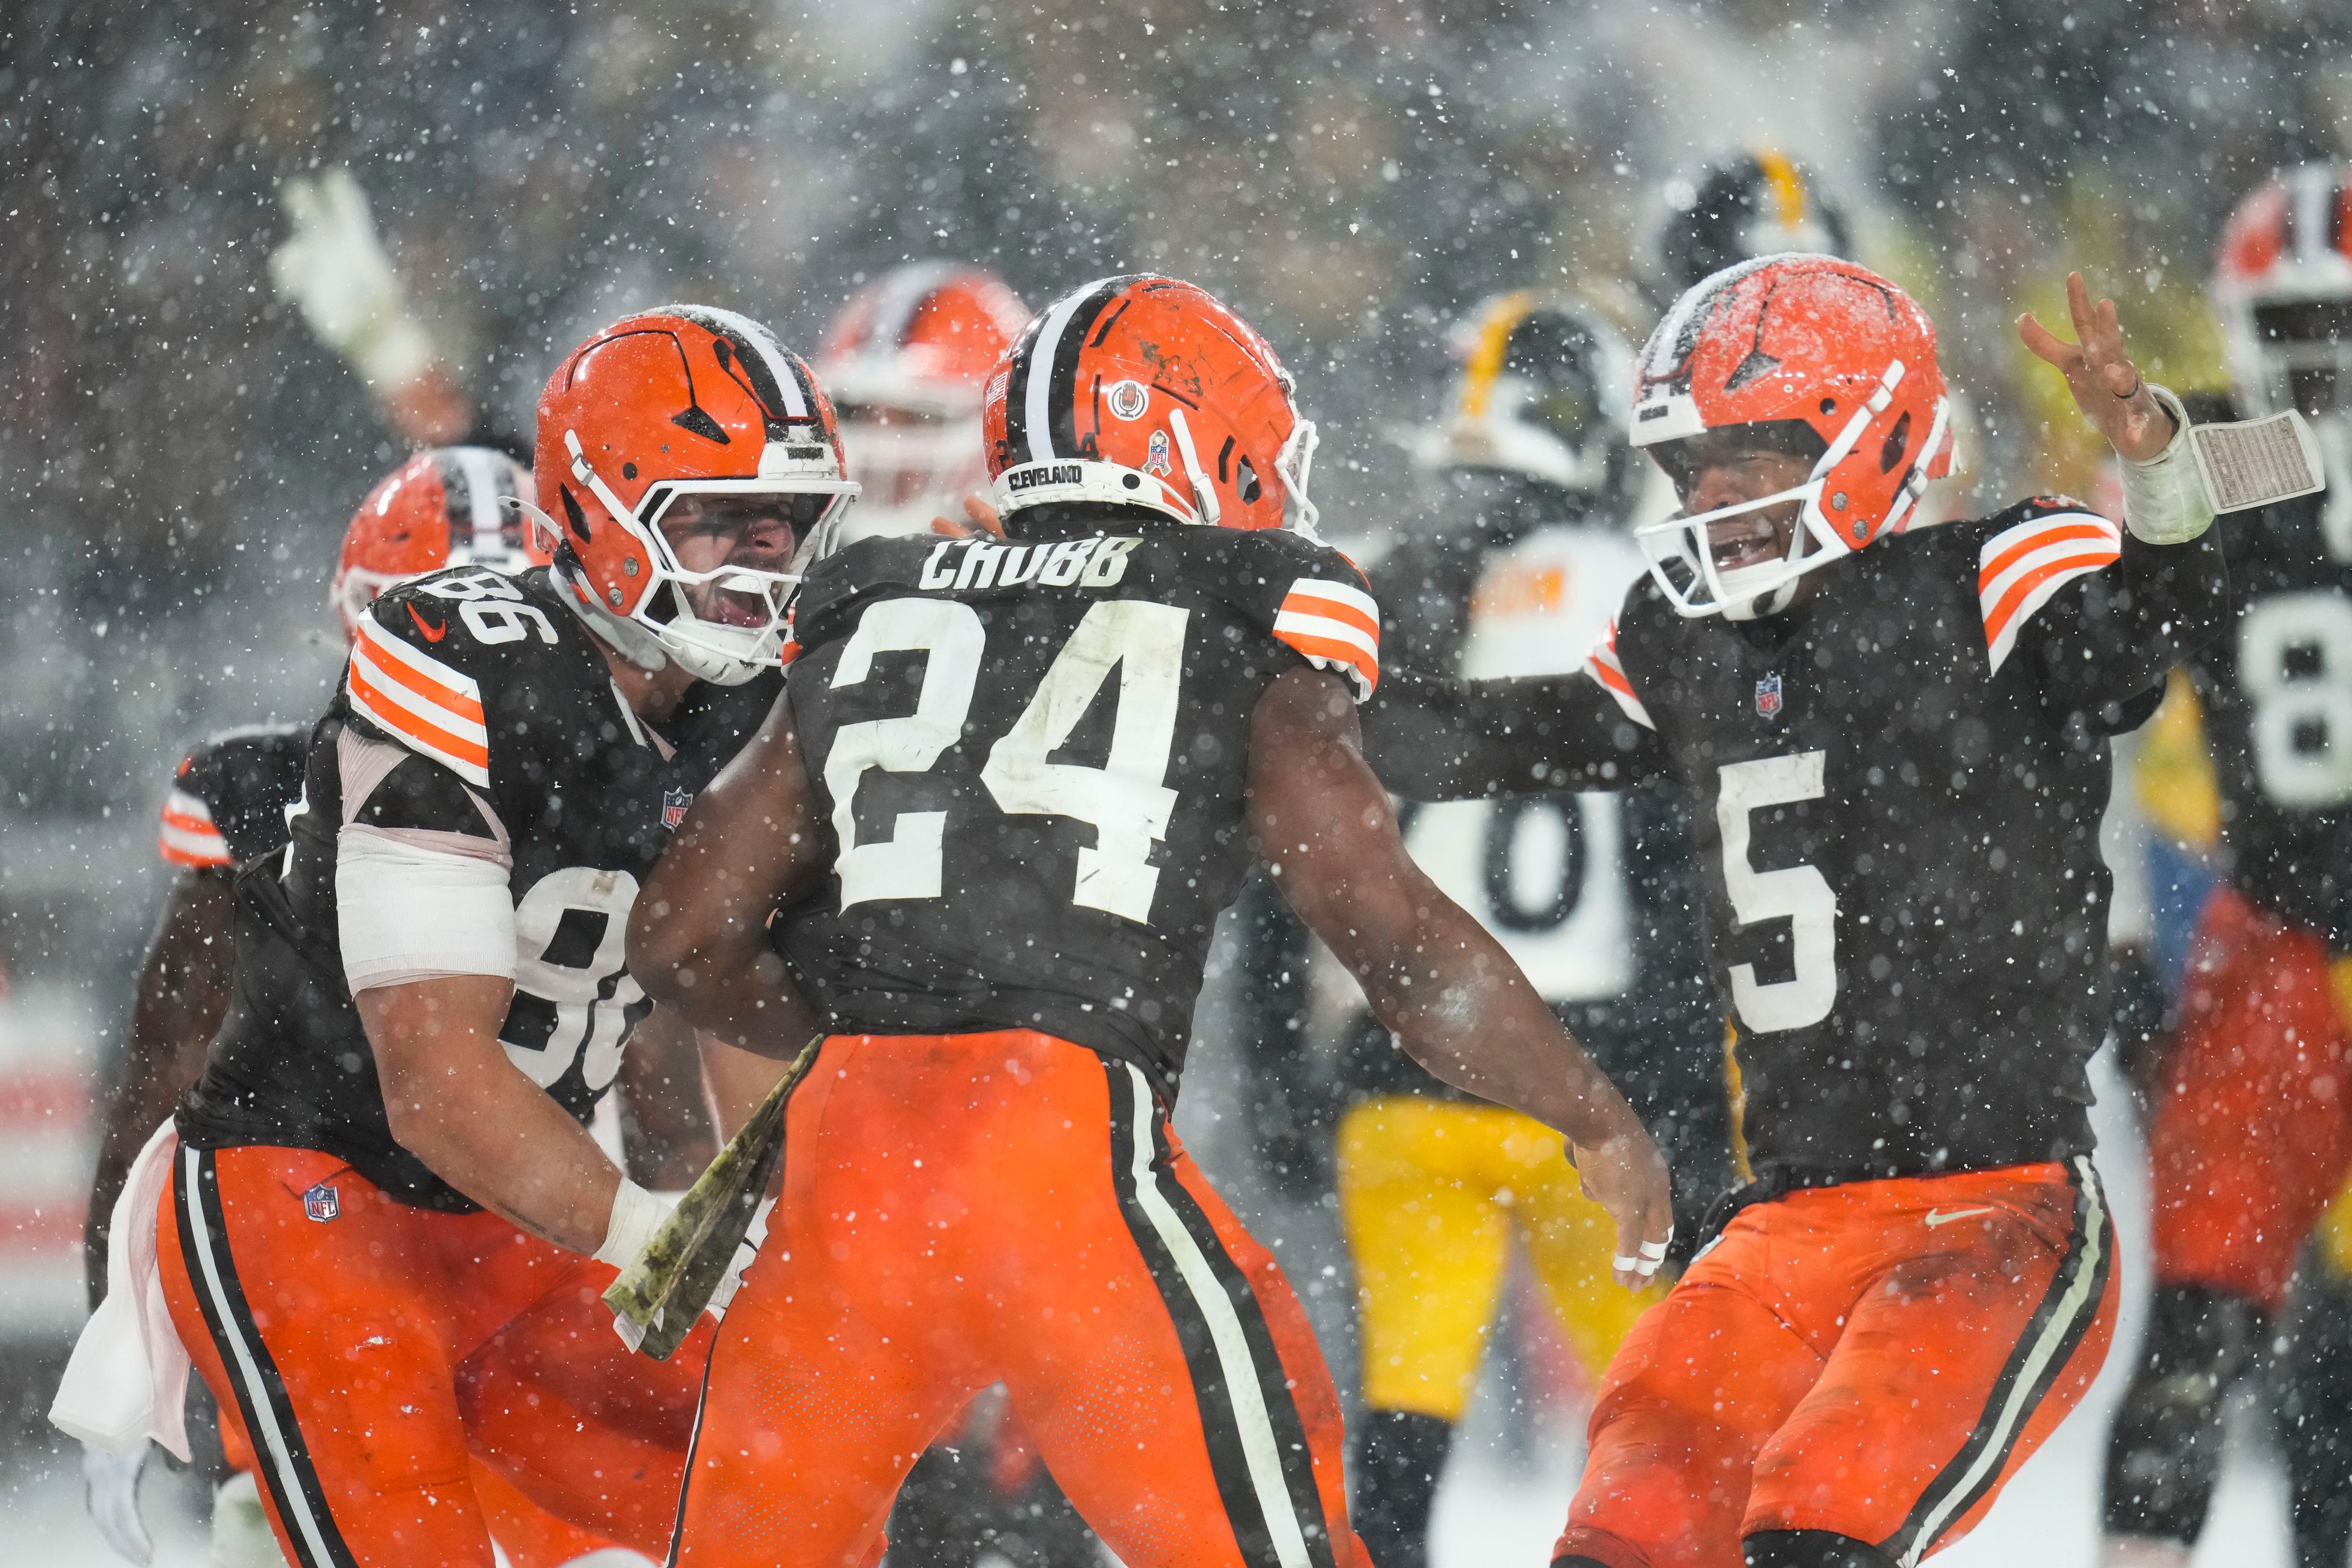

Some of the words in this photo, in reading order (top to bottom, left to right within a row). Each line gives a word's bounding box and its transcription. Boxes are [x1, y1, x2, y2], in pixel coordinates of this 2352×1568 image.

[1008, 466, 1082, 491] CLEVELAND
[1152, 453, 1165, 463] NFL
[918, 537, 1144, 590] CHUBB
[417, 572, 559, 644] 86
[824, 597, 1190, 926] 24
[1717, 750, 1838, 1034] 5
[310, 1201, 335, 1216] NFL
